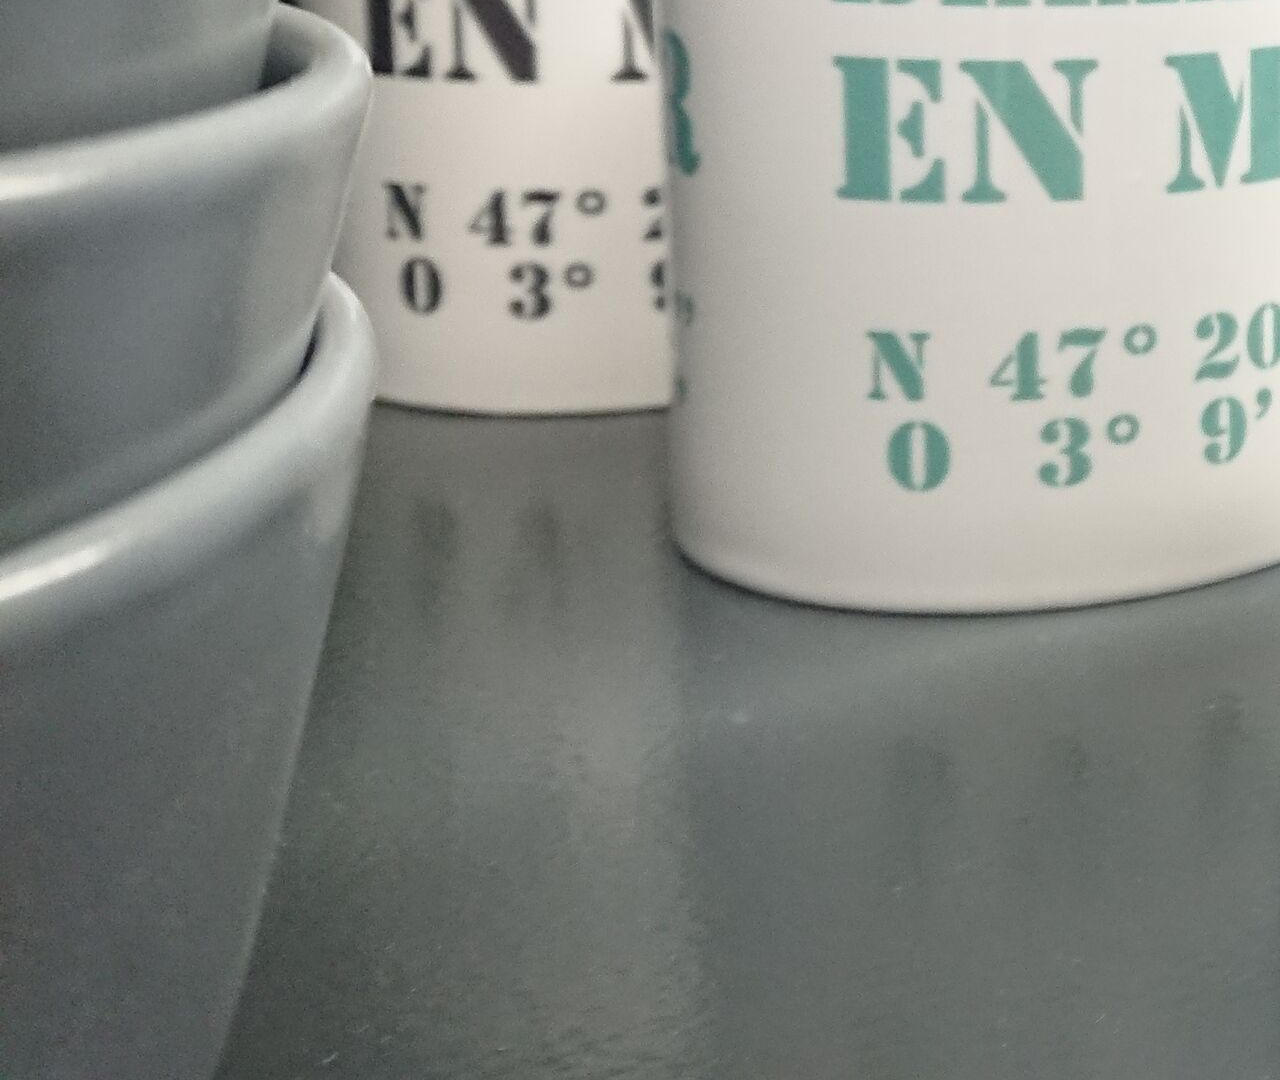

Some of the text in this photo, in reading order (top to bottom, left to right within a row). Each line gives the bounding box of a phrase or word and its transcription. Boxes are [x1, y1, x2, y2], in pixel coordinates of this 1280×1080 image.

[832, 56, 1099, 204] EN
[383, 180, 427, 241] N
[400, 257, 442, 315] O
[866, 331, 931, 402] N
[886, 421, 951, 493] O
